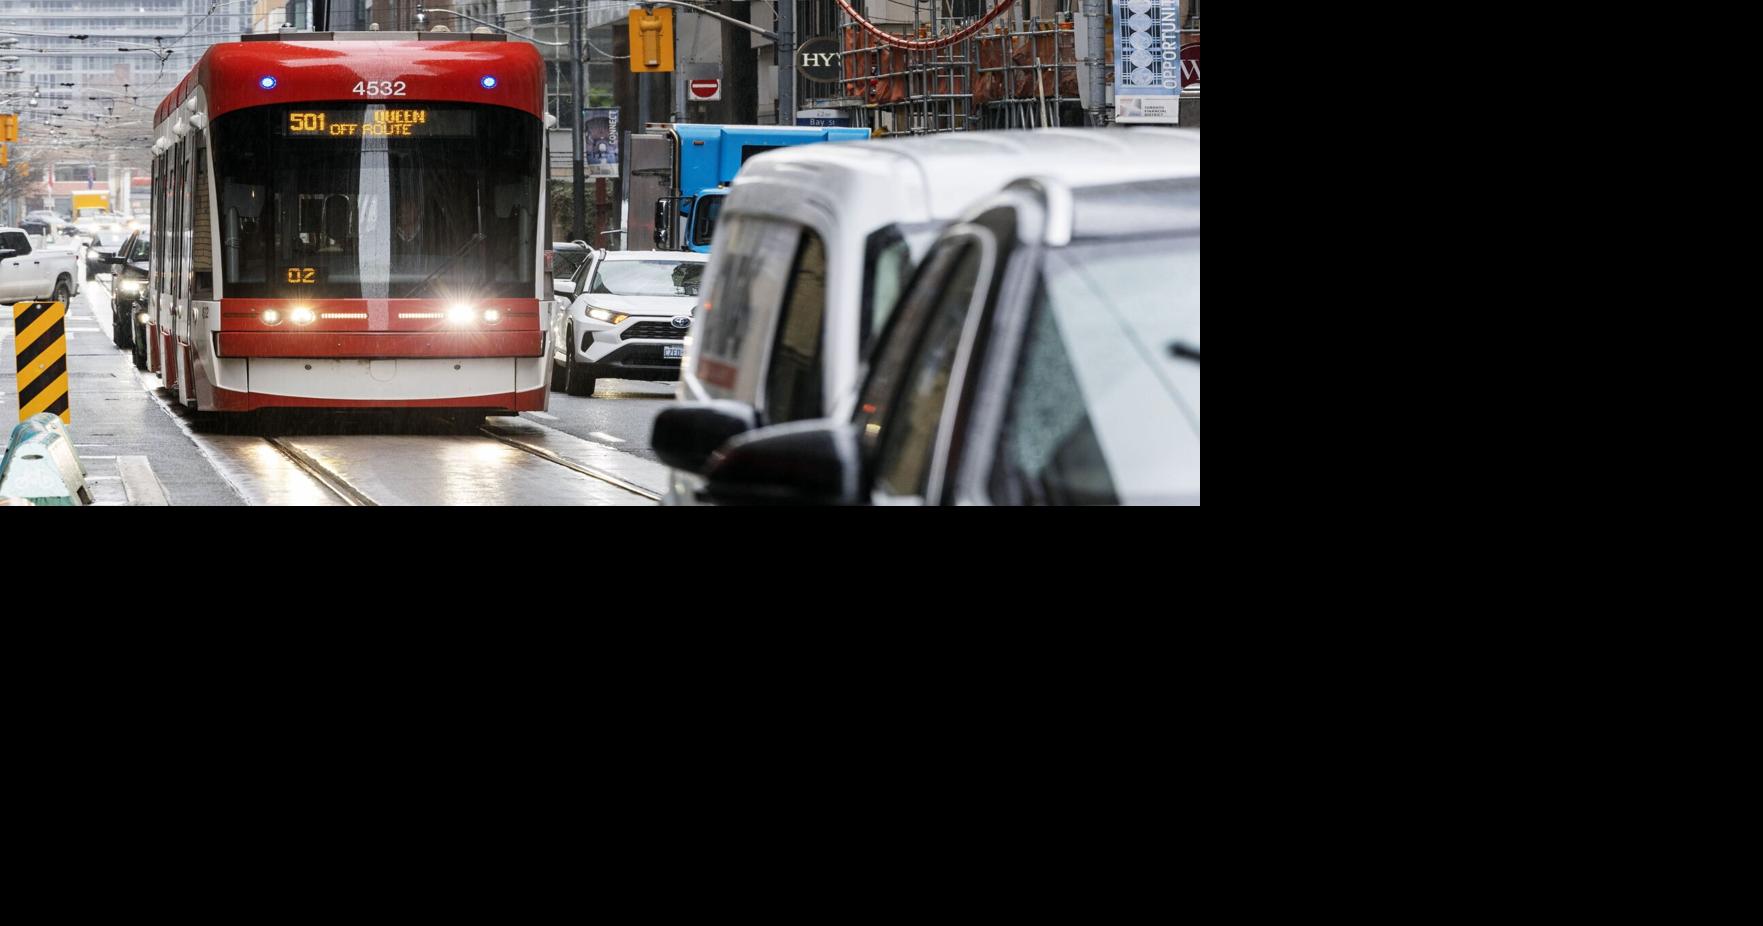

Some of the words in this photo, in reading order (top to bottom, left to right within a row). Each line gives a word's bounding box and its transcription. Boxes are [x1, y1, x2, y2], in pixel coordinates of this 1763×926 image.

[352, 81, 407, 96] 4532
[290, 112, 326, 131] 501
[374, 110, 426, 123] QUEEN
[810, 118, 825, 127] Bay
[330, 124, 357, 136] OFF
[362, 124, 412, 135] ROUTE
[288, 267, 316, 284] 02
